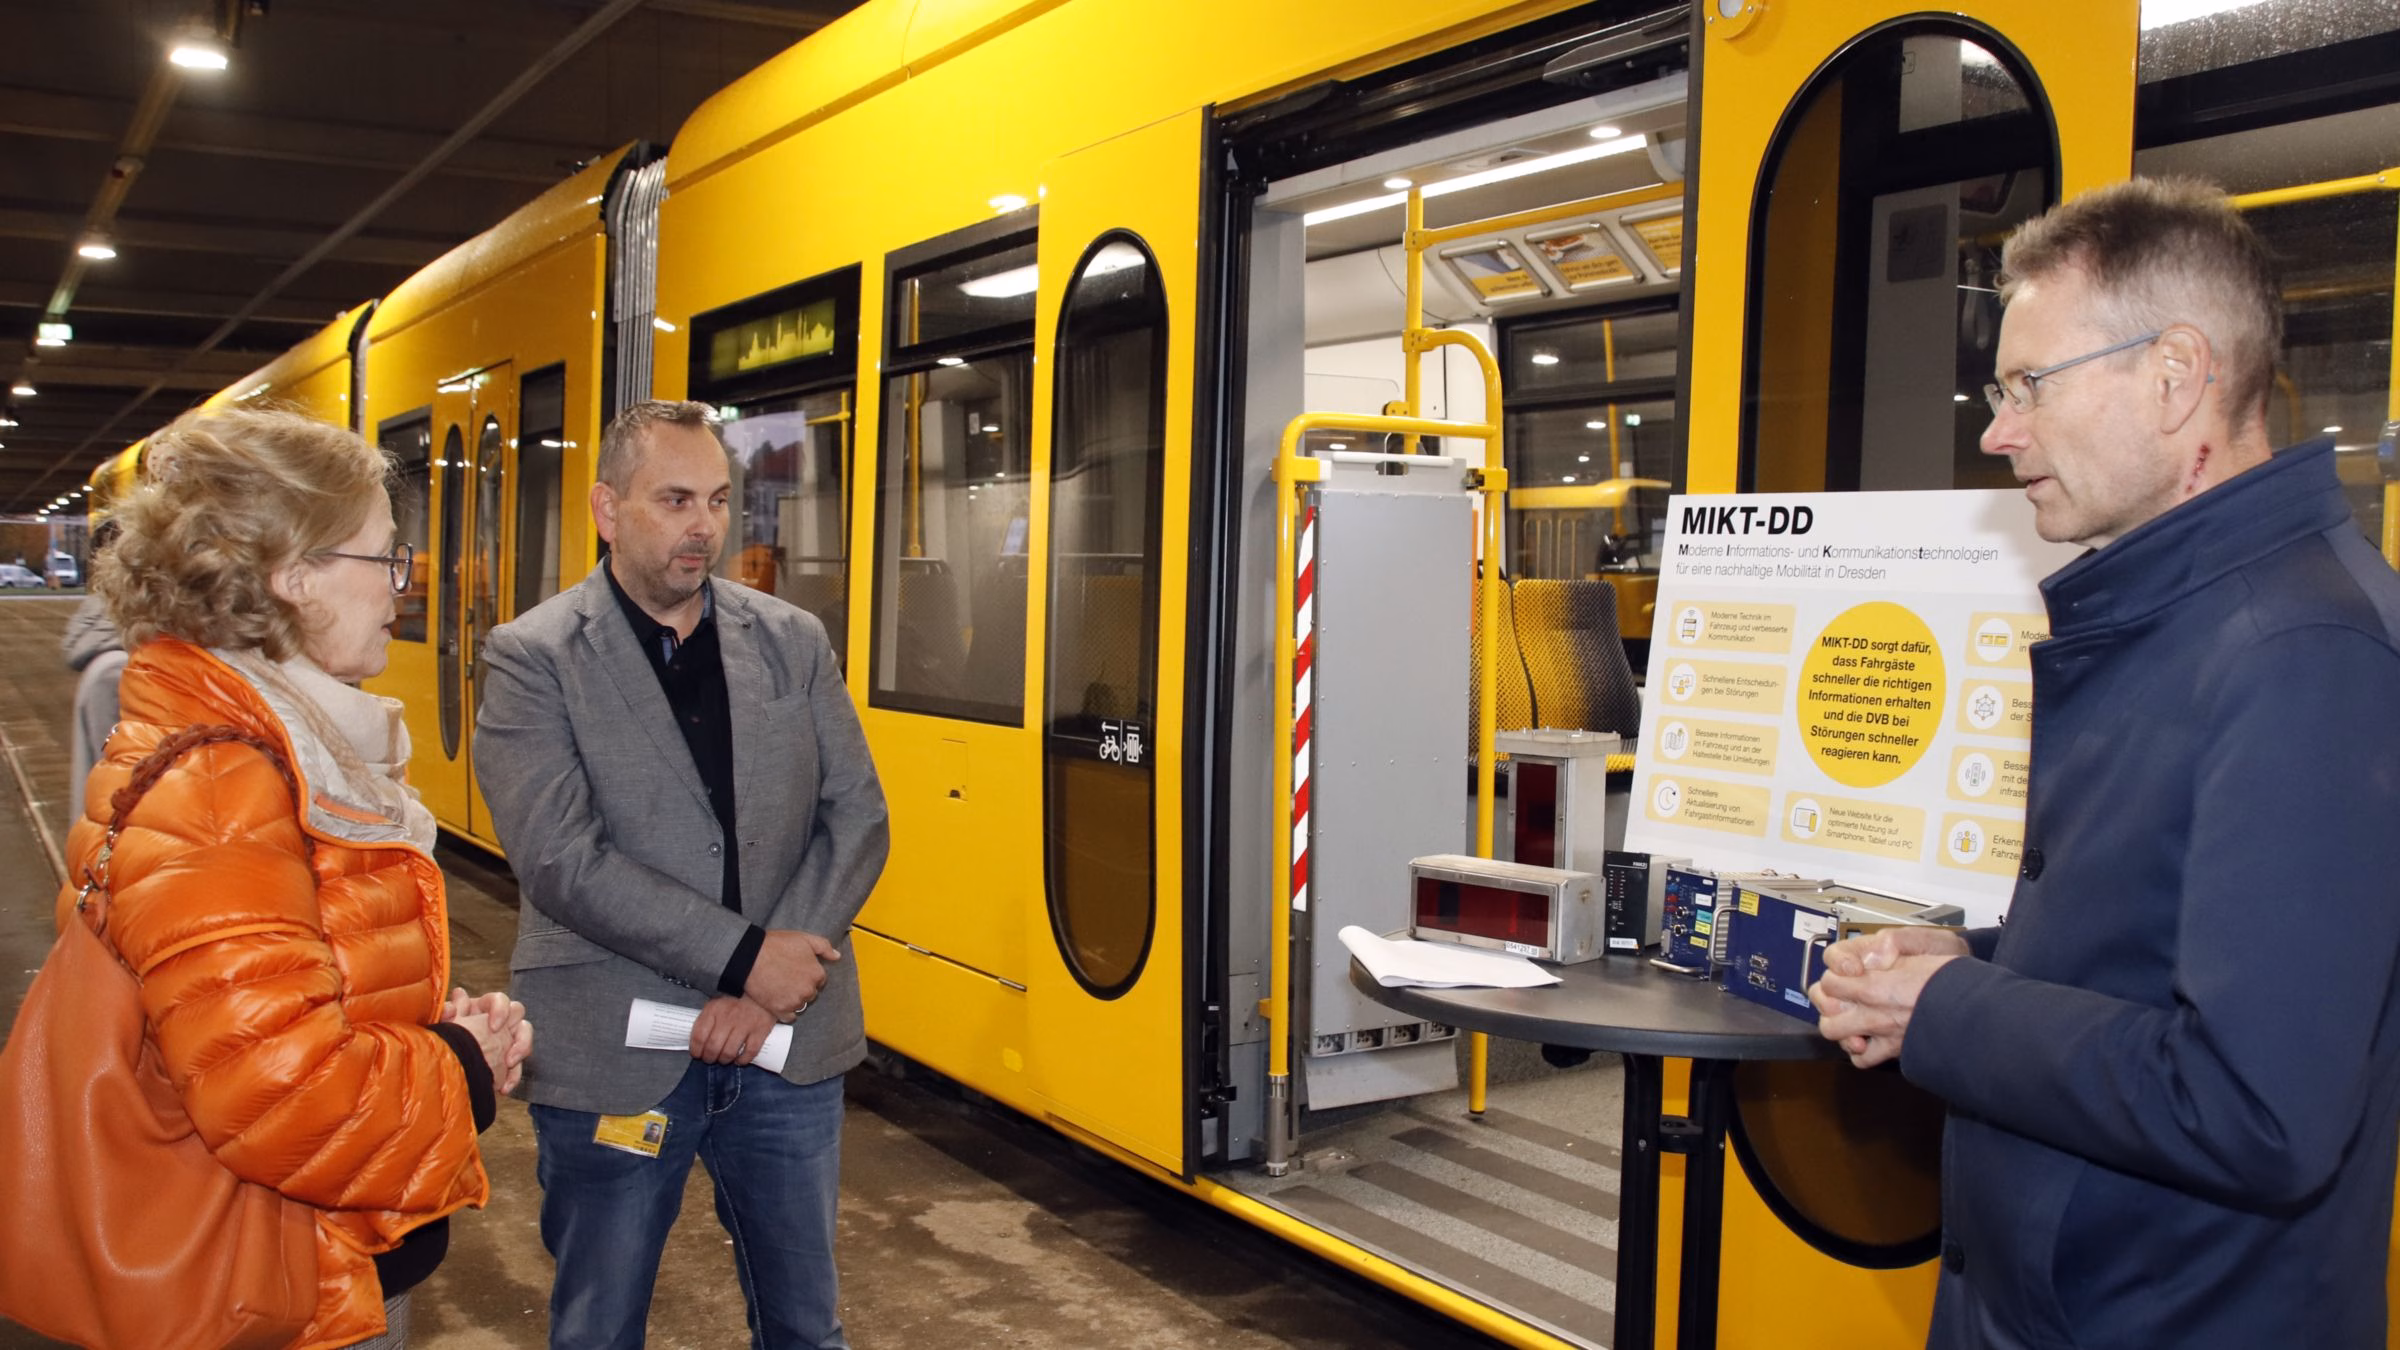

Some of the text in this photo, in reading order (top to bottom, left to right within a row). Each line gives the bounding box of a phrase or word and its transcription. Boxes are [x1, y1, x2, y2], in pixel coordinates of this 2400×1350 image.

[1681, 506, 1814, 535] MIKT-DD
[1678, 544, 1999, 564] Moderne Informations- und Kommunikationstechnologien
[1676, 563, 1887, 580] für eine nachhaltige Mobilität in Dresden
[1711, 611, 1738, 620] Moderne
[1739, 612, 1762, 621] Technik
[1709, 622, 1737, 633] Fahrzeug
[1708, 633, 1755, 643] Kommunikation
[1821, 636, 1932, 655] MIKT-DD sorgt dafür,
[1832, 656, 1915, 672] dass Fahrgäste
[1812, 673, 1932, 693] schneller die richtigen
[1808, 689, 1932, 710] Informationen erhalten
[1823, 710, 1910, 727] und die DVB bei
[1810, 725, 1919, 746] Störungen schneller
[1821, 746, 1901, 764] reagieren kann.
[2001, 775, 2015, 783] mit
[1901, 840, 1913, 849] PC
